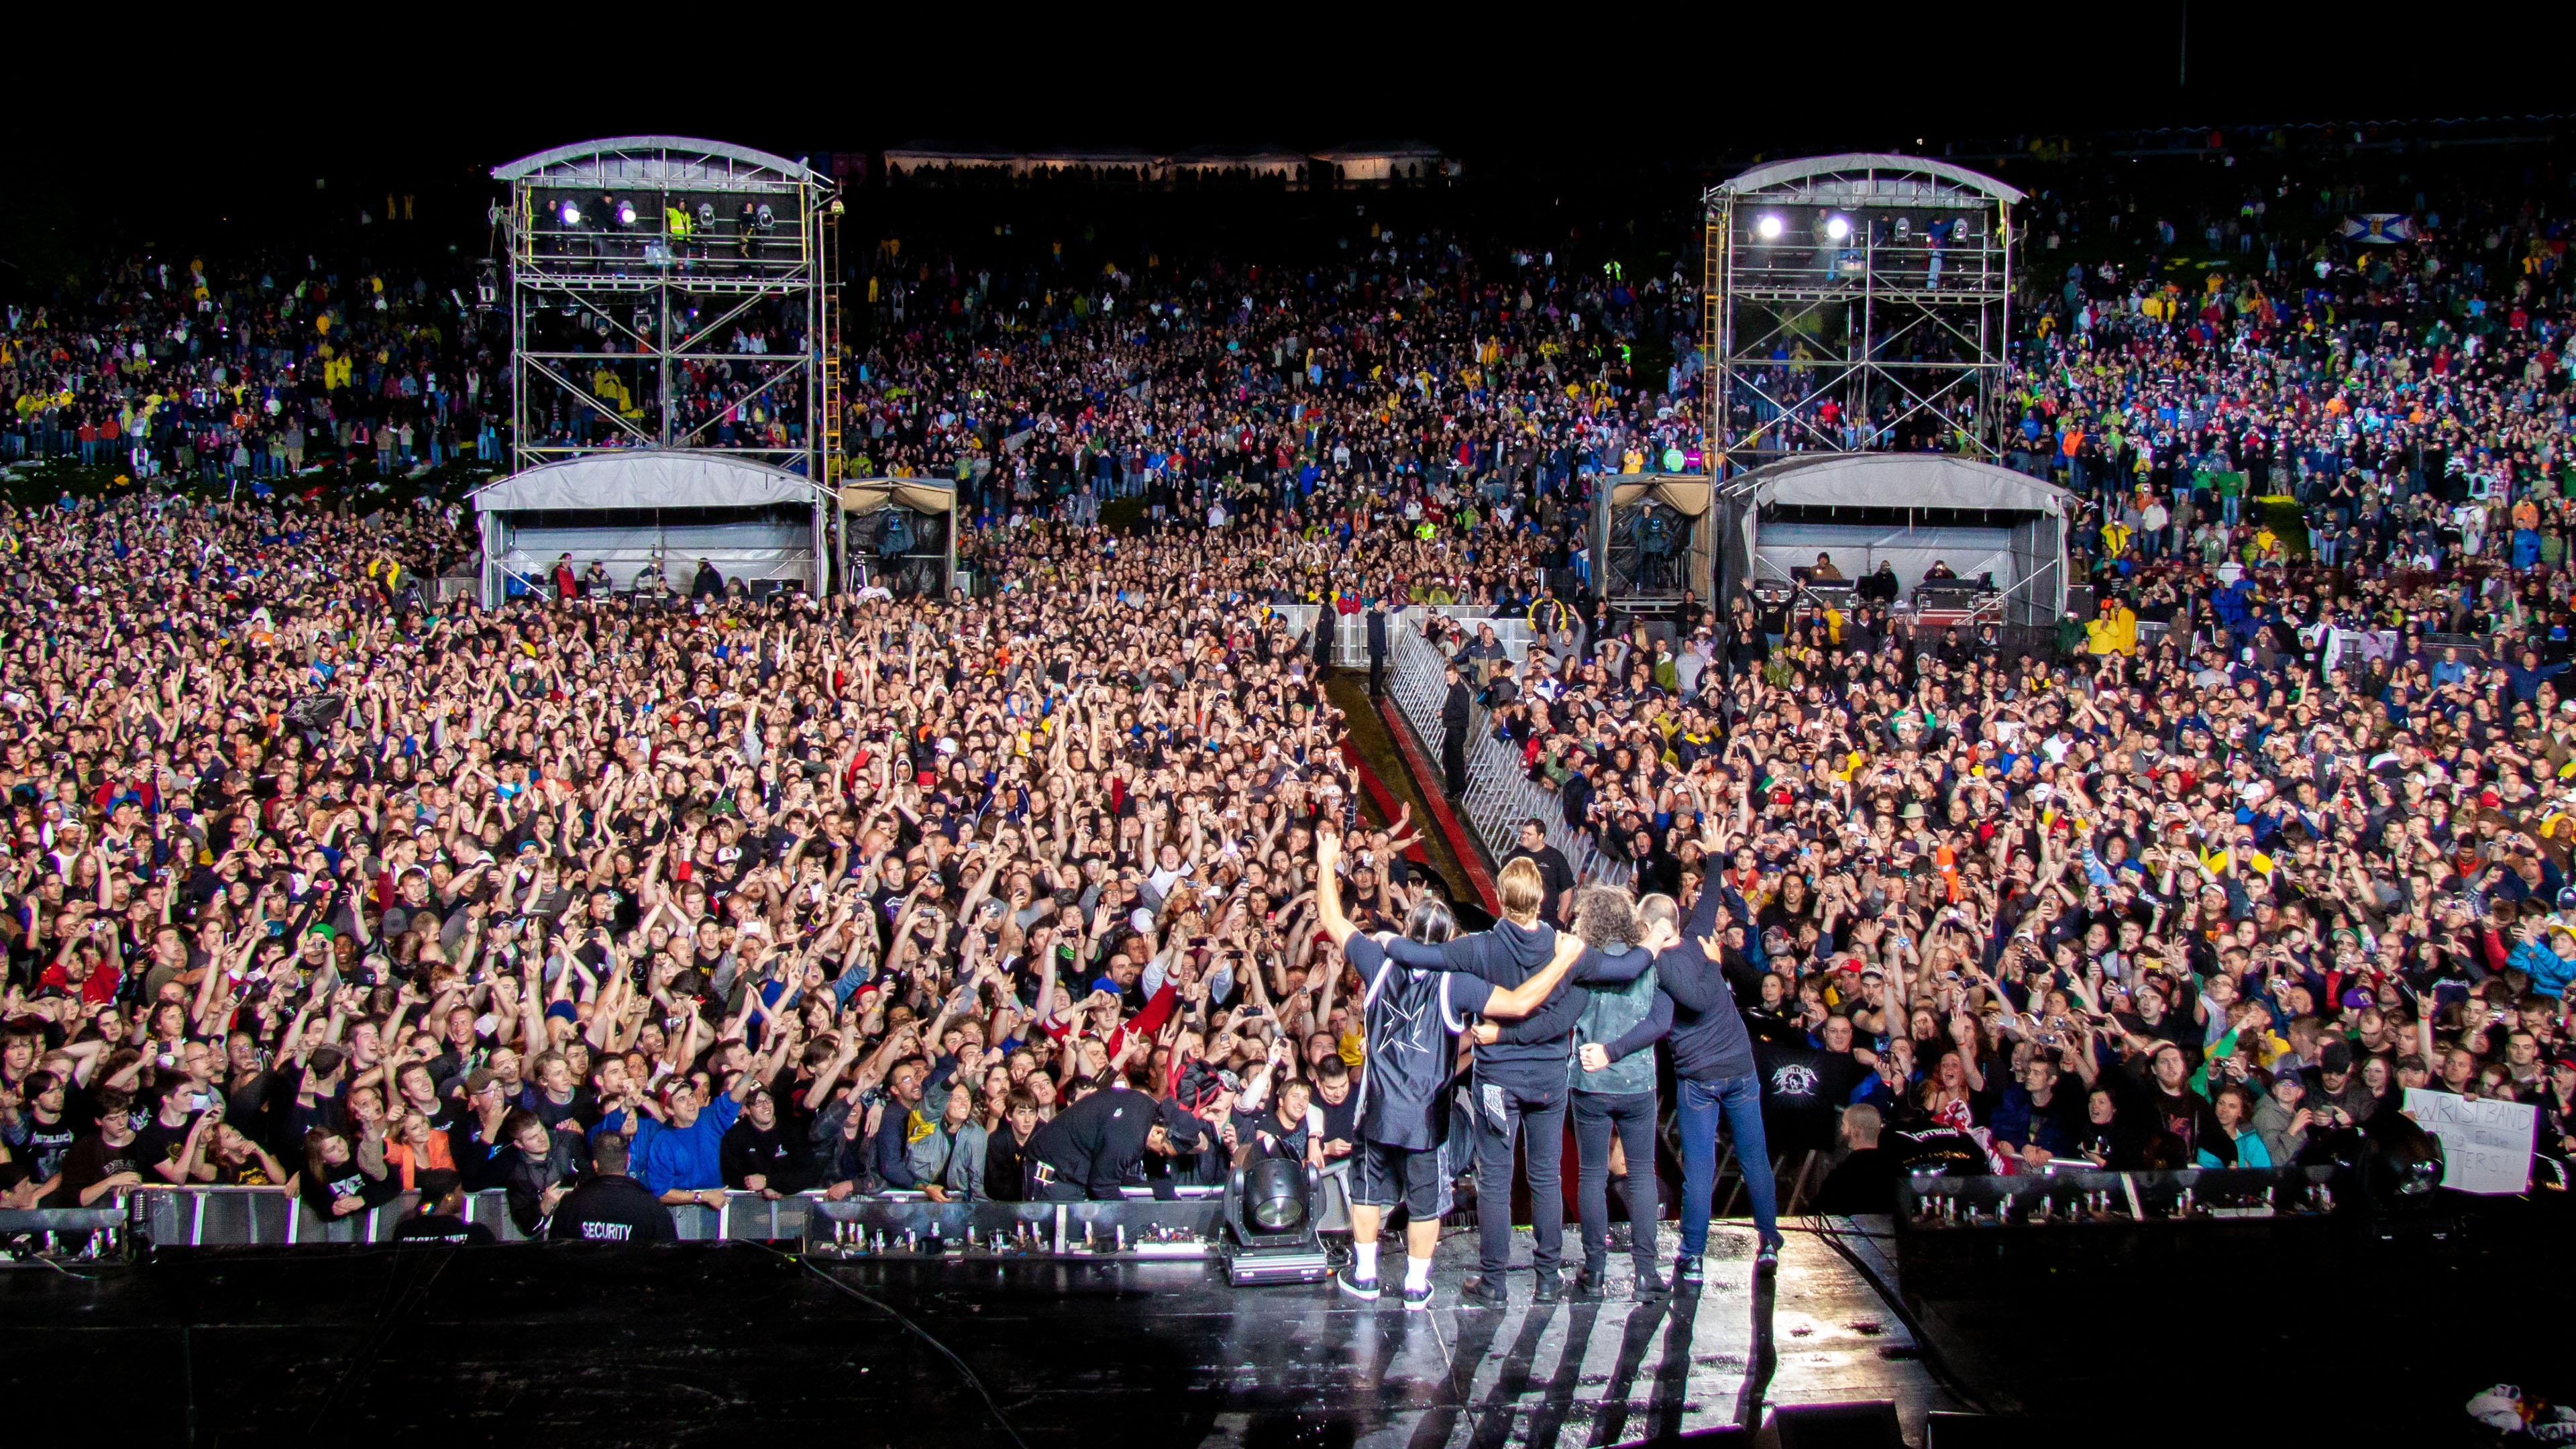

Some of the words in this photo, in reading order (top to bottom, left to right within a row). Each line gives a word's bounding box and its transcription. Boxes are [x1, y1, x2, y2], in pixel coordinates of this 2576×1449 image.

[2410, 1092, 2531, 1130] WRISTBAND
[2432, 1125, 2465, 1147] thing
[582, 1221, 632, 1240] SECURITY
